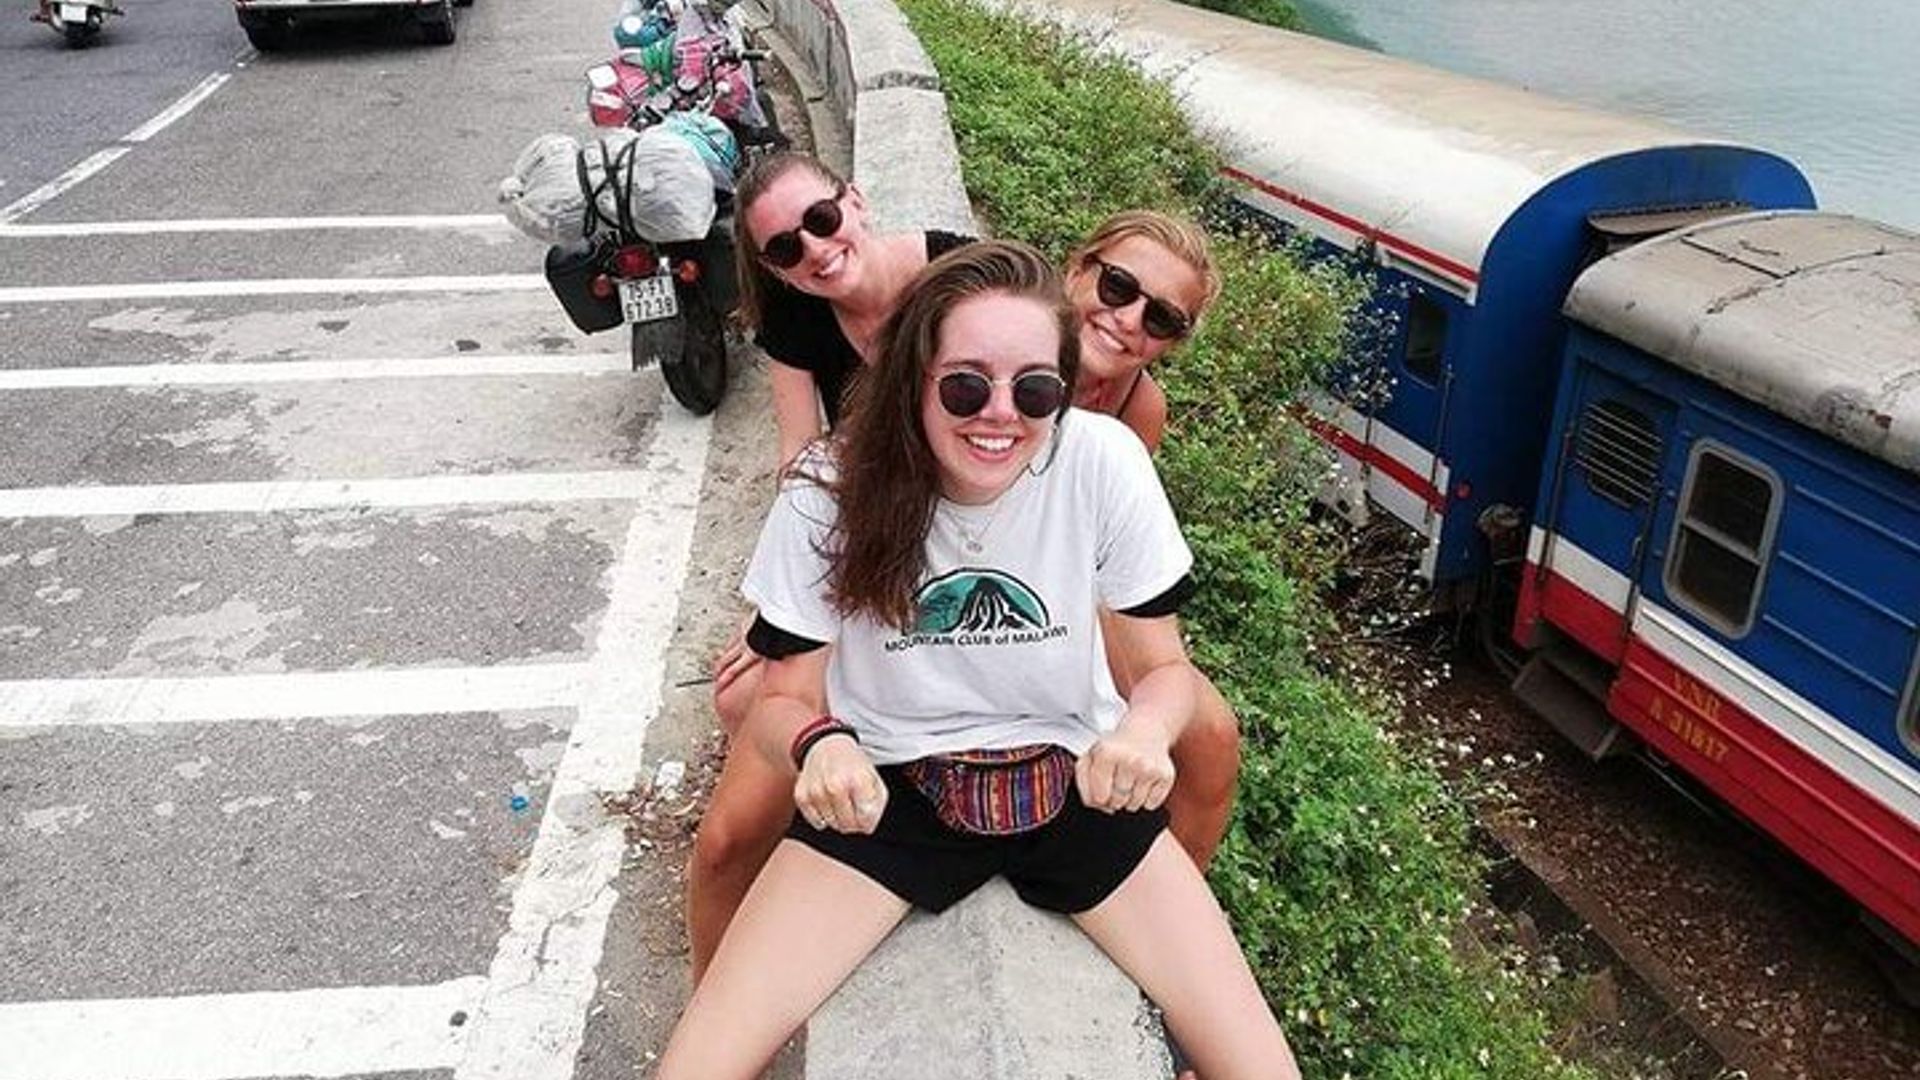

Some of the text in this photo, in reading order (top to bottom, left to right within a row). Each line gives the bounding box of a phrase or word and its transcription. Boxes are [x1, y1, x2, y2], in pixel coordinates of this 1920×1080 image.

[884, 626, 1069, 651] MOUNTAIN CLUB of MALAWI
